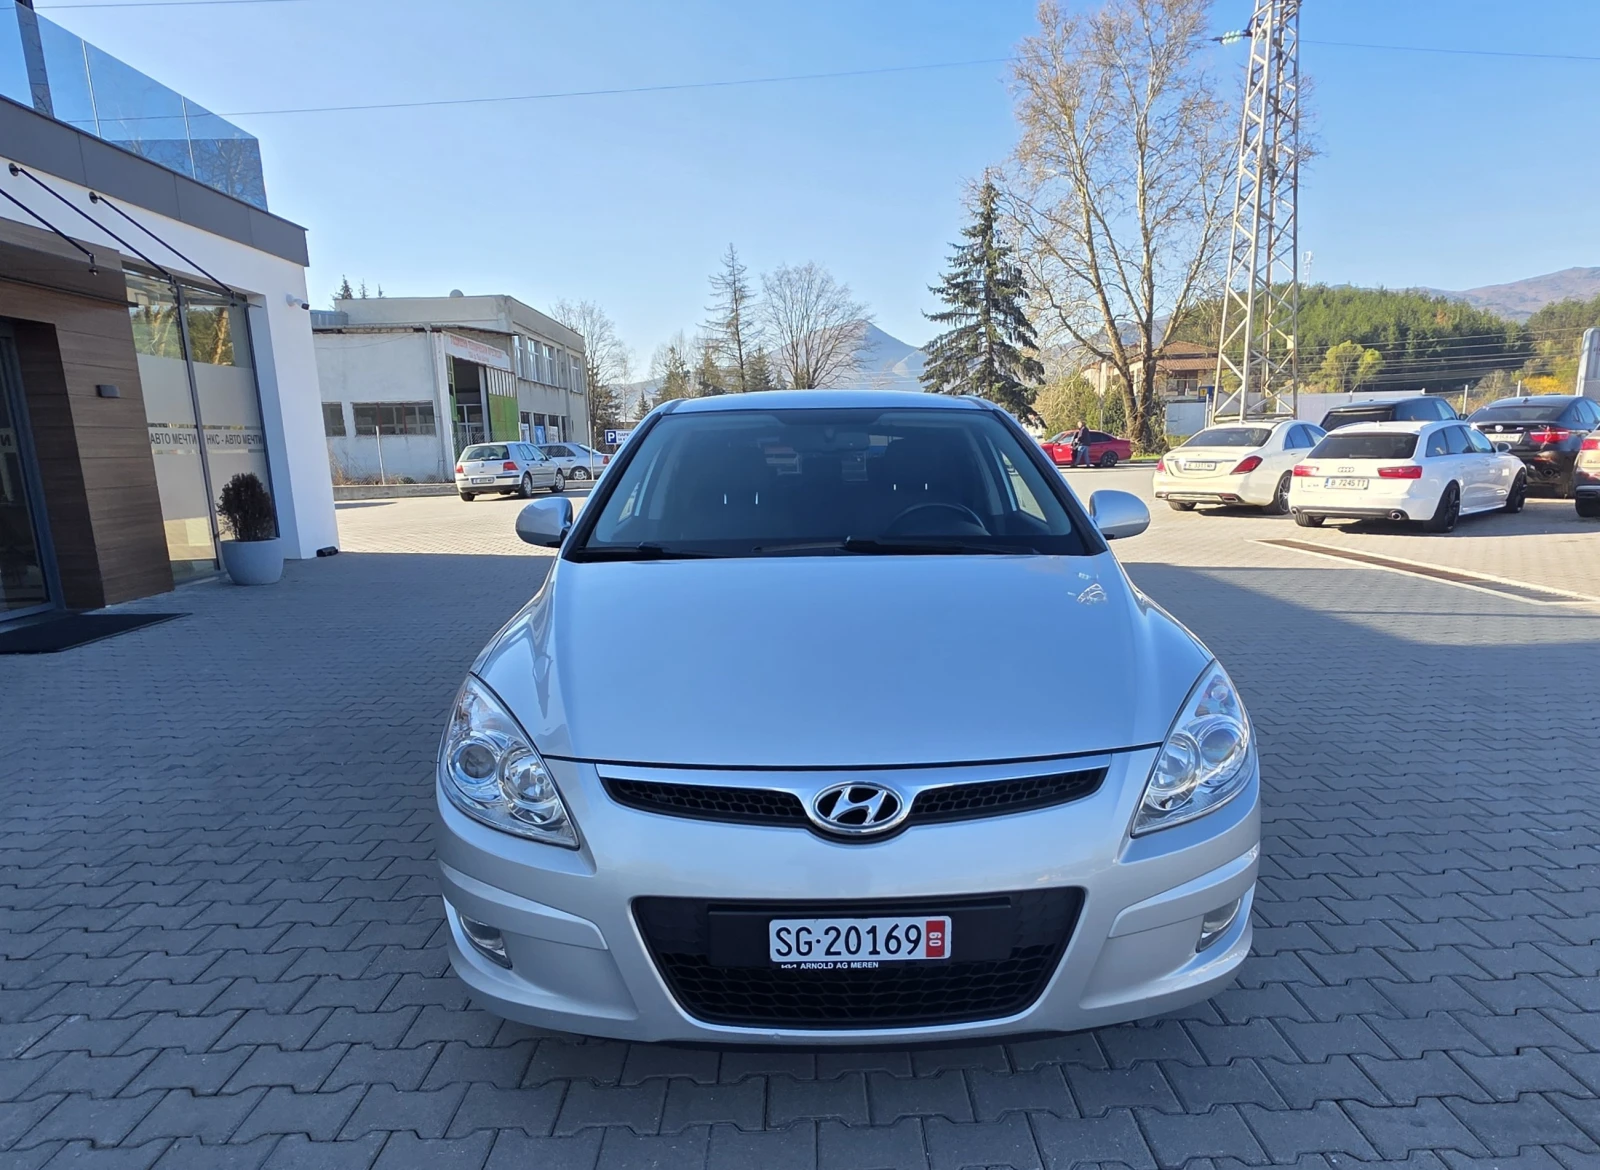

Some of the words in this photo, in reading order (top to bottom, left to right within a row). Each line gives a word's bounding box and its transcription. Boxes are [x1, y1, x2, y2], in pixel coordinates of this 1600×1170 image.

[150, 433, 171, 444] АВТО
[172, 433, 197, 444] МЕЧТИ
[206, 434, 220, 444] НКС
[225, 434, 242, 444] АВТО
